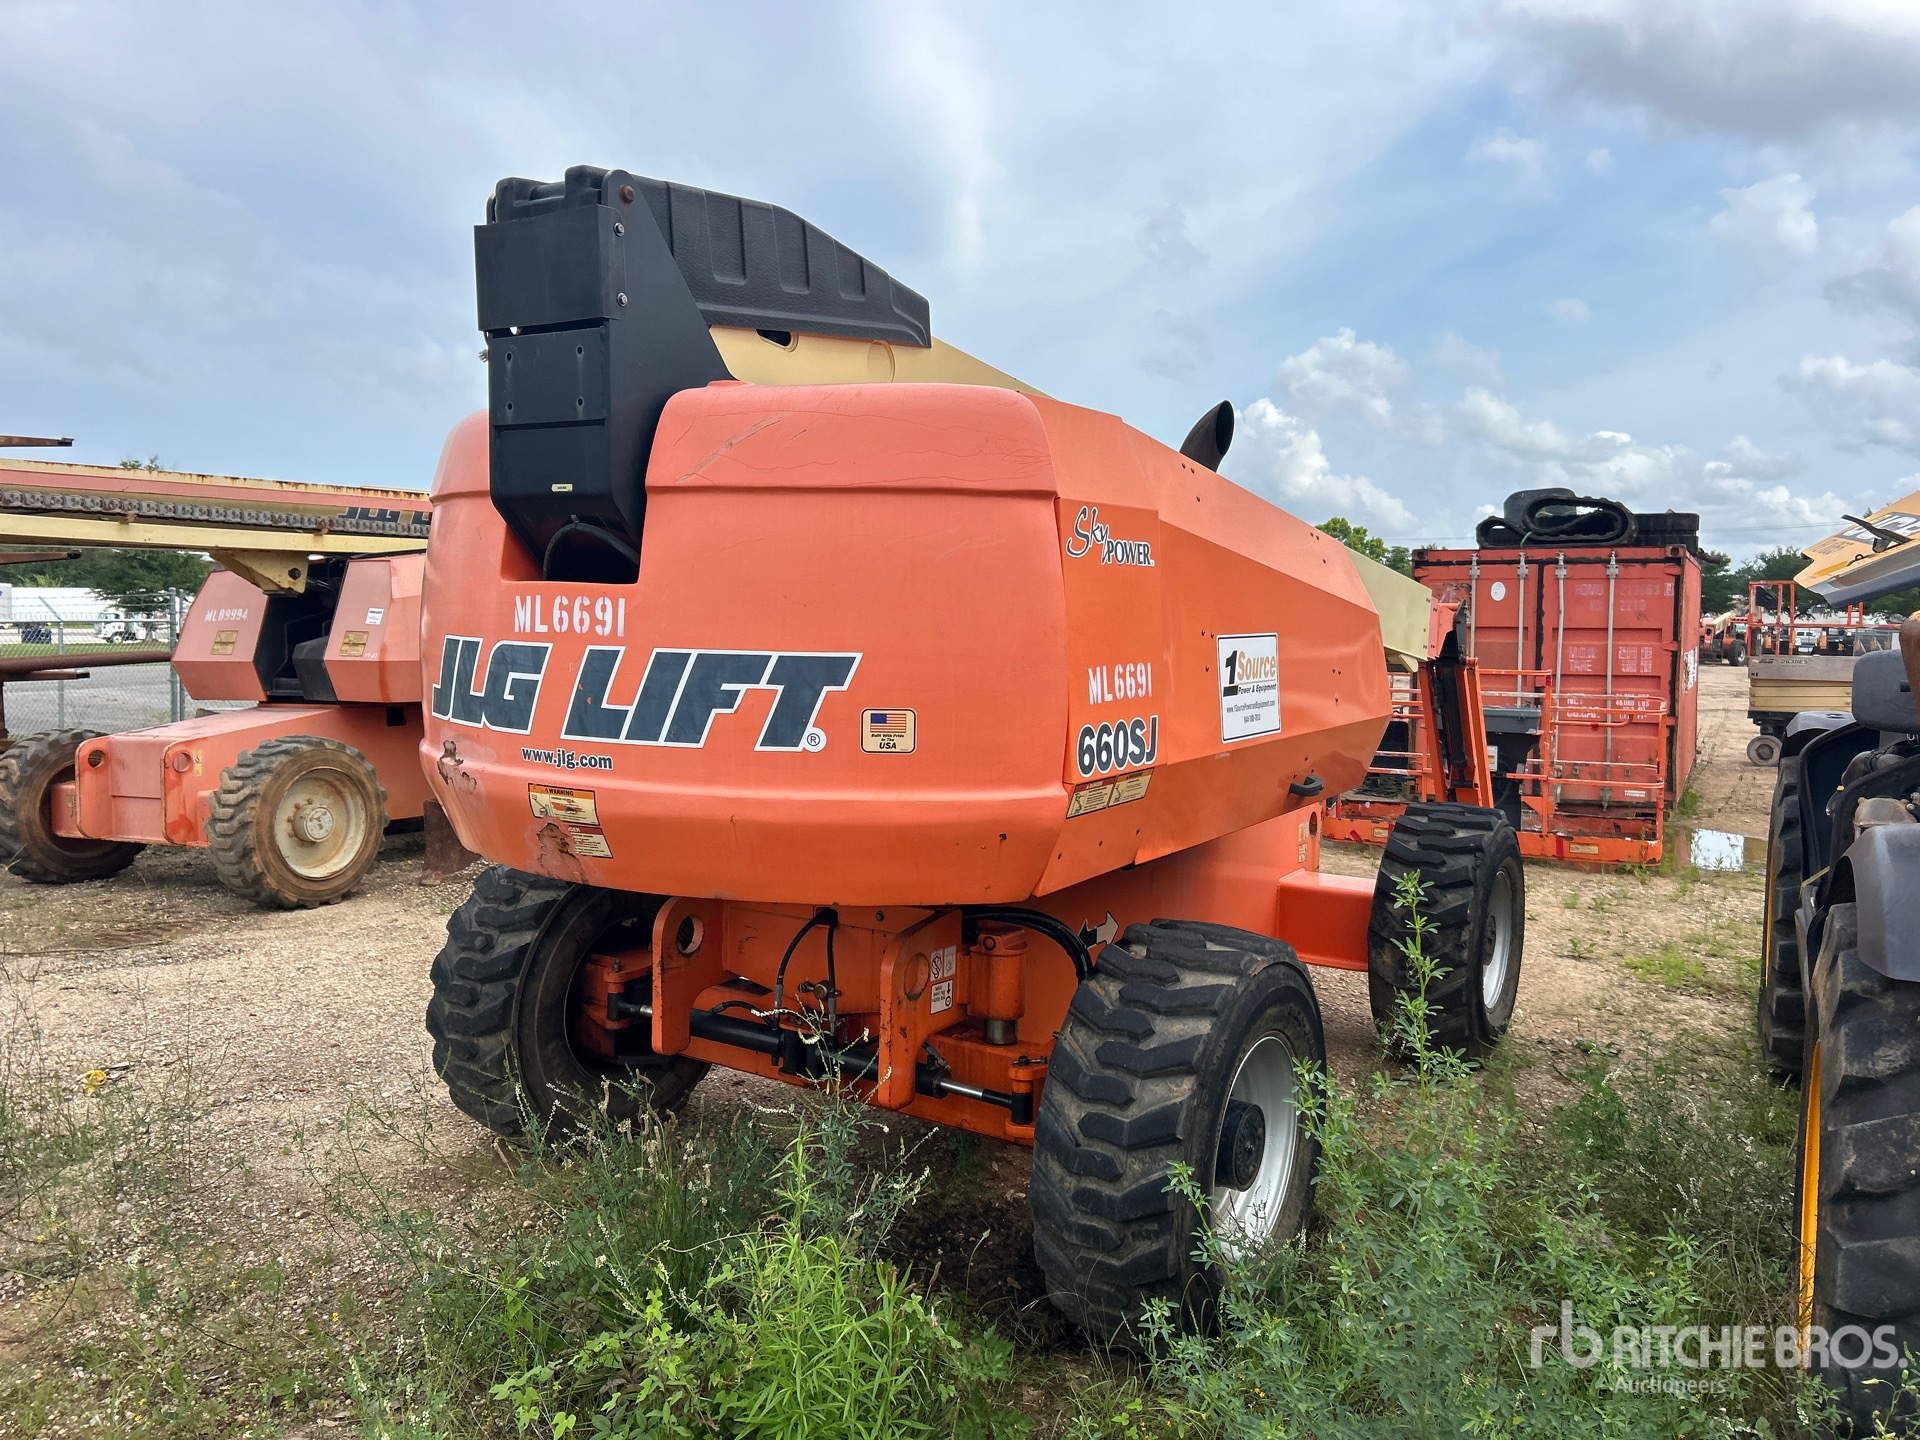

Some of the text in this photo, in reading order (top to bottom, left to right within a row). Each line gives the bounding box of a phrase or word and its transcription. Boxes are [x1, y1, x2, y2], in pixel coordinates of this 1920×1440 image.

[1066, 506, 1152, 565] Sky POWER
[1237, 651, 1276, 681] Source
[432, 635, 553, 735] JLG
[560, 645, 863, 752] LIFT
[1238, 686, 1252, 695] Power
[1256, 683, 1276, 695] Equipment
[521, 748, 614, 770] www.jlg.com
[1077, 715, 1158, 778] 660SJ
[548, 788, 574, 797] WARNING
